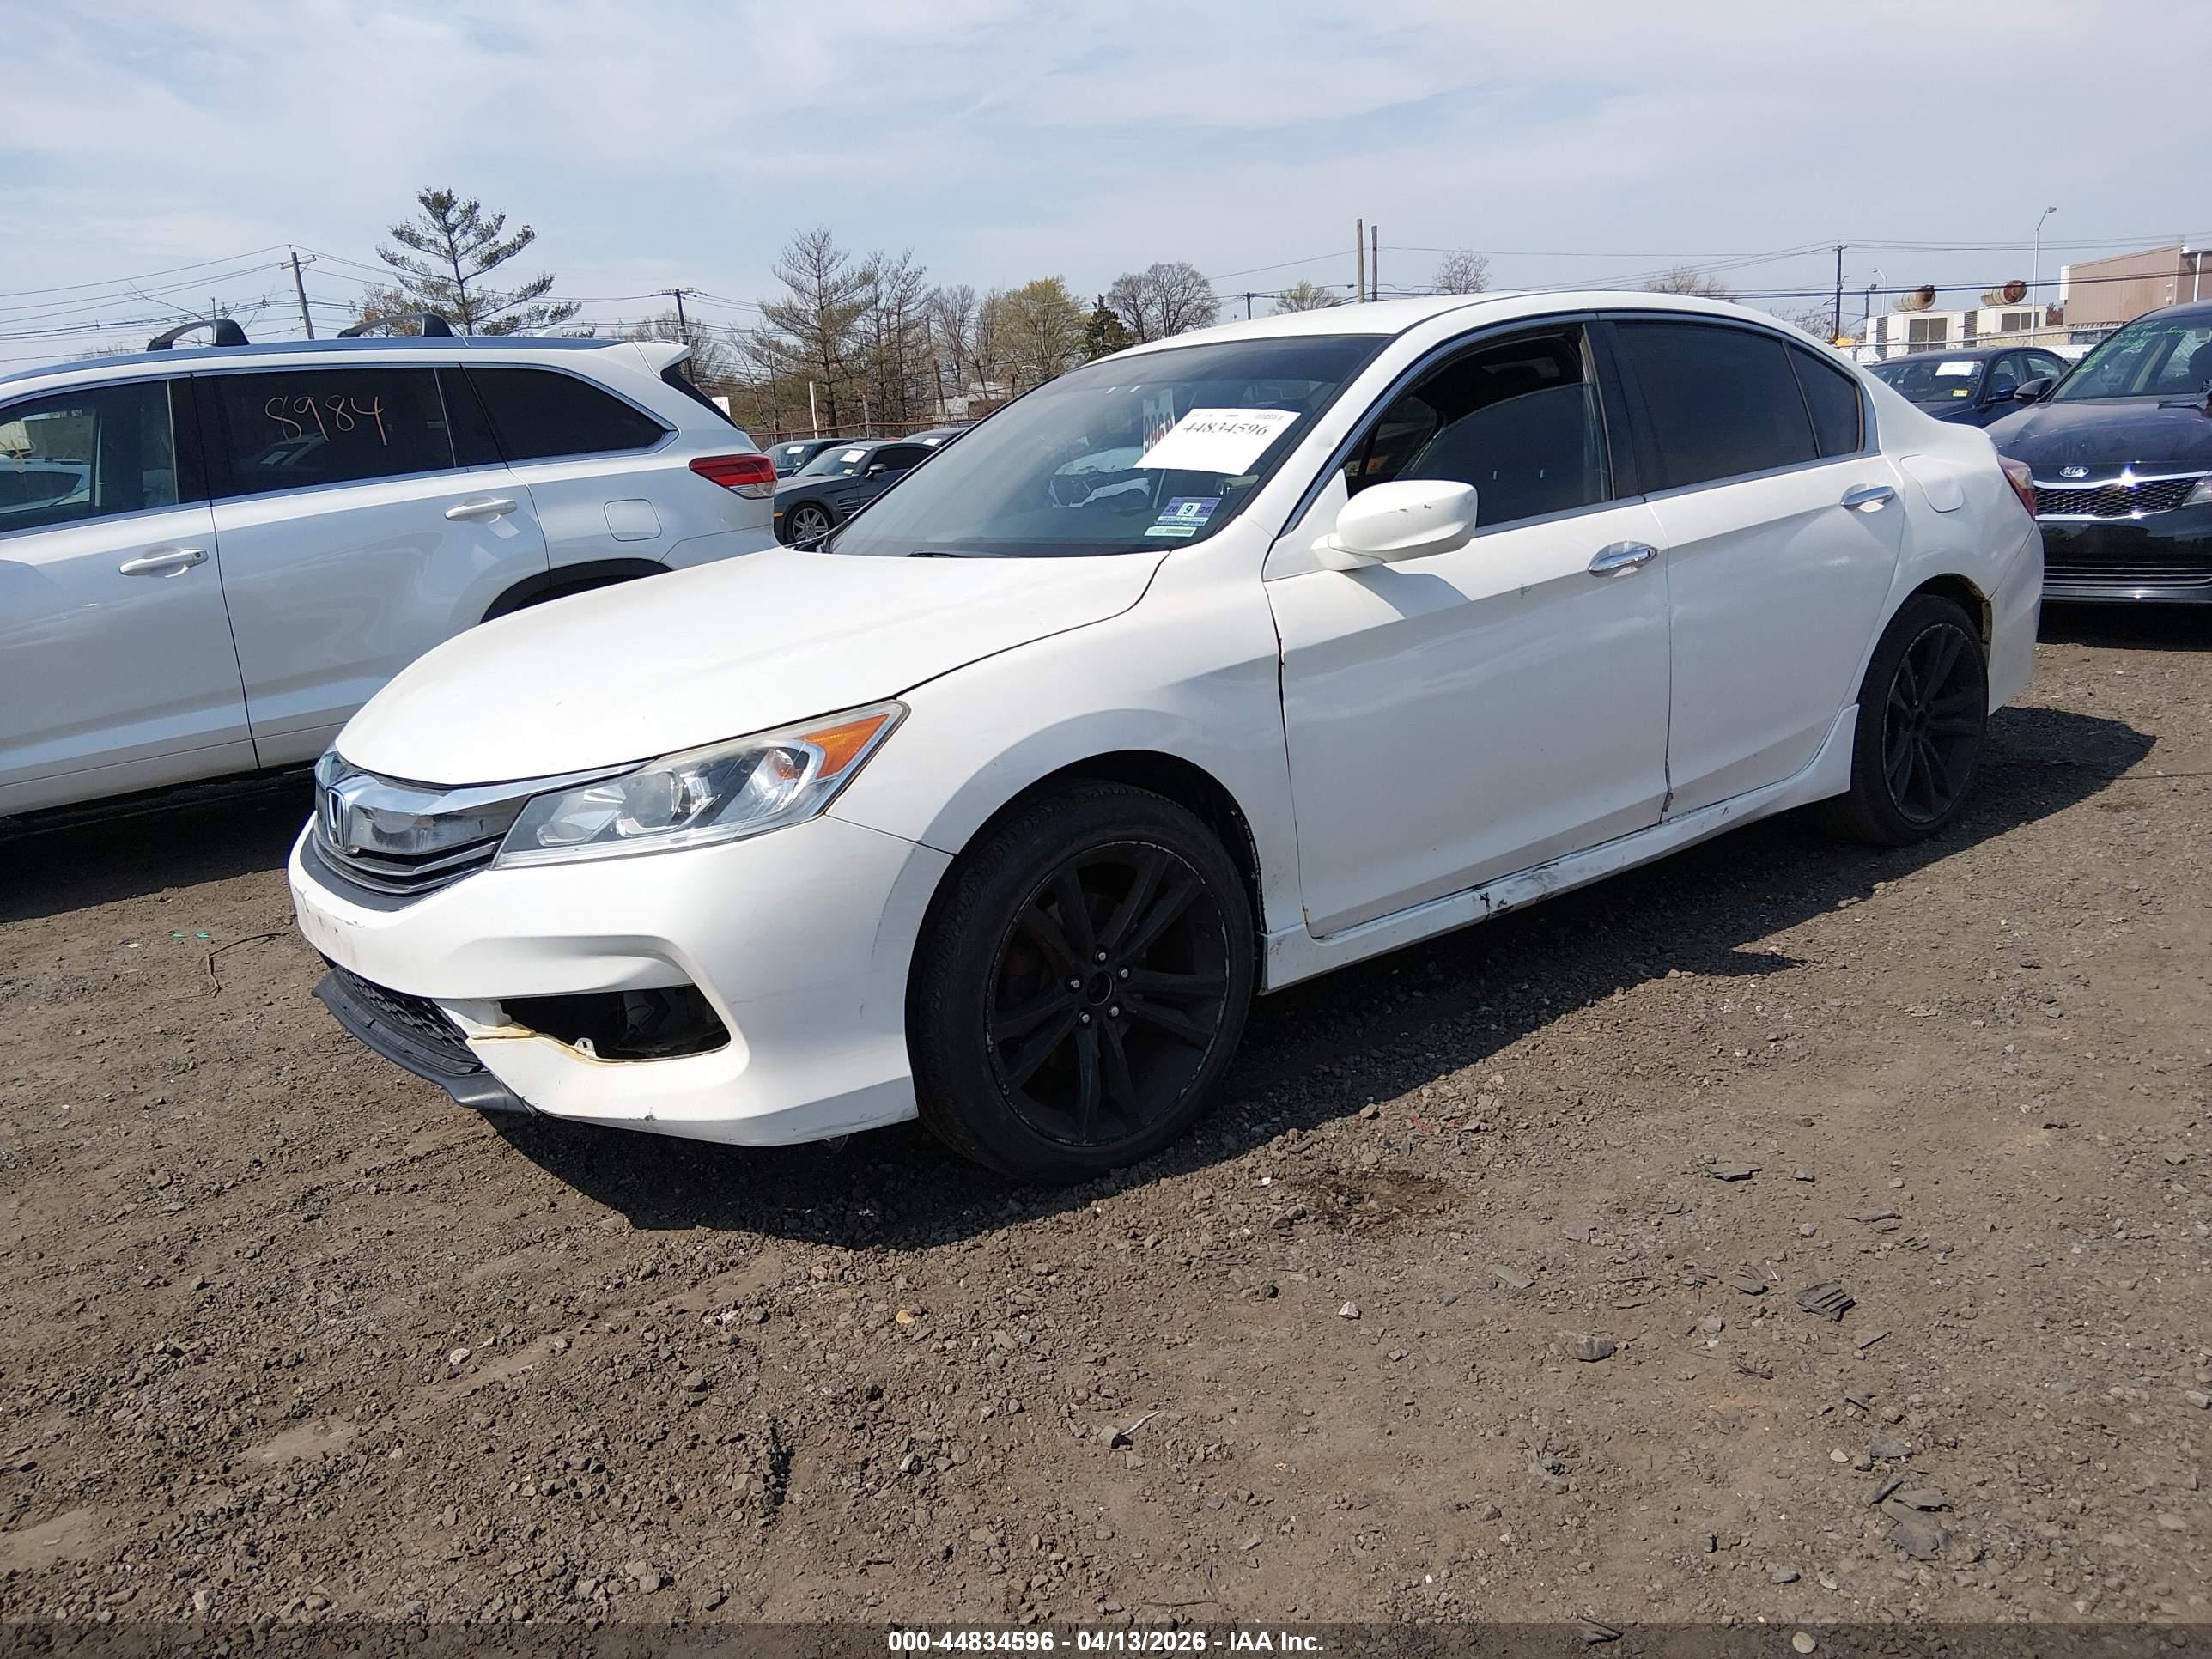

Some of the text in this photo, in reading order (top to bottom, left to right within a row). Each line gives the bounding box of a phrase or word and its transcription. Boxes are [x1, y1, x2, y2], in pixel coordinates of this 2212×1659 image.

[264, 395, 387, 447] 8984
[1183, 422, 1271, 435] 44834596
[2063, 466, 2087, 477] KIA
[1182, 504, 1194, 515] 9
